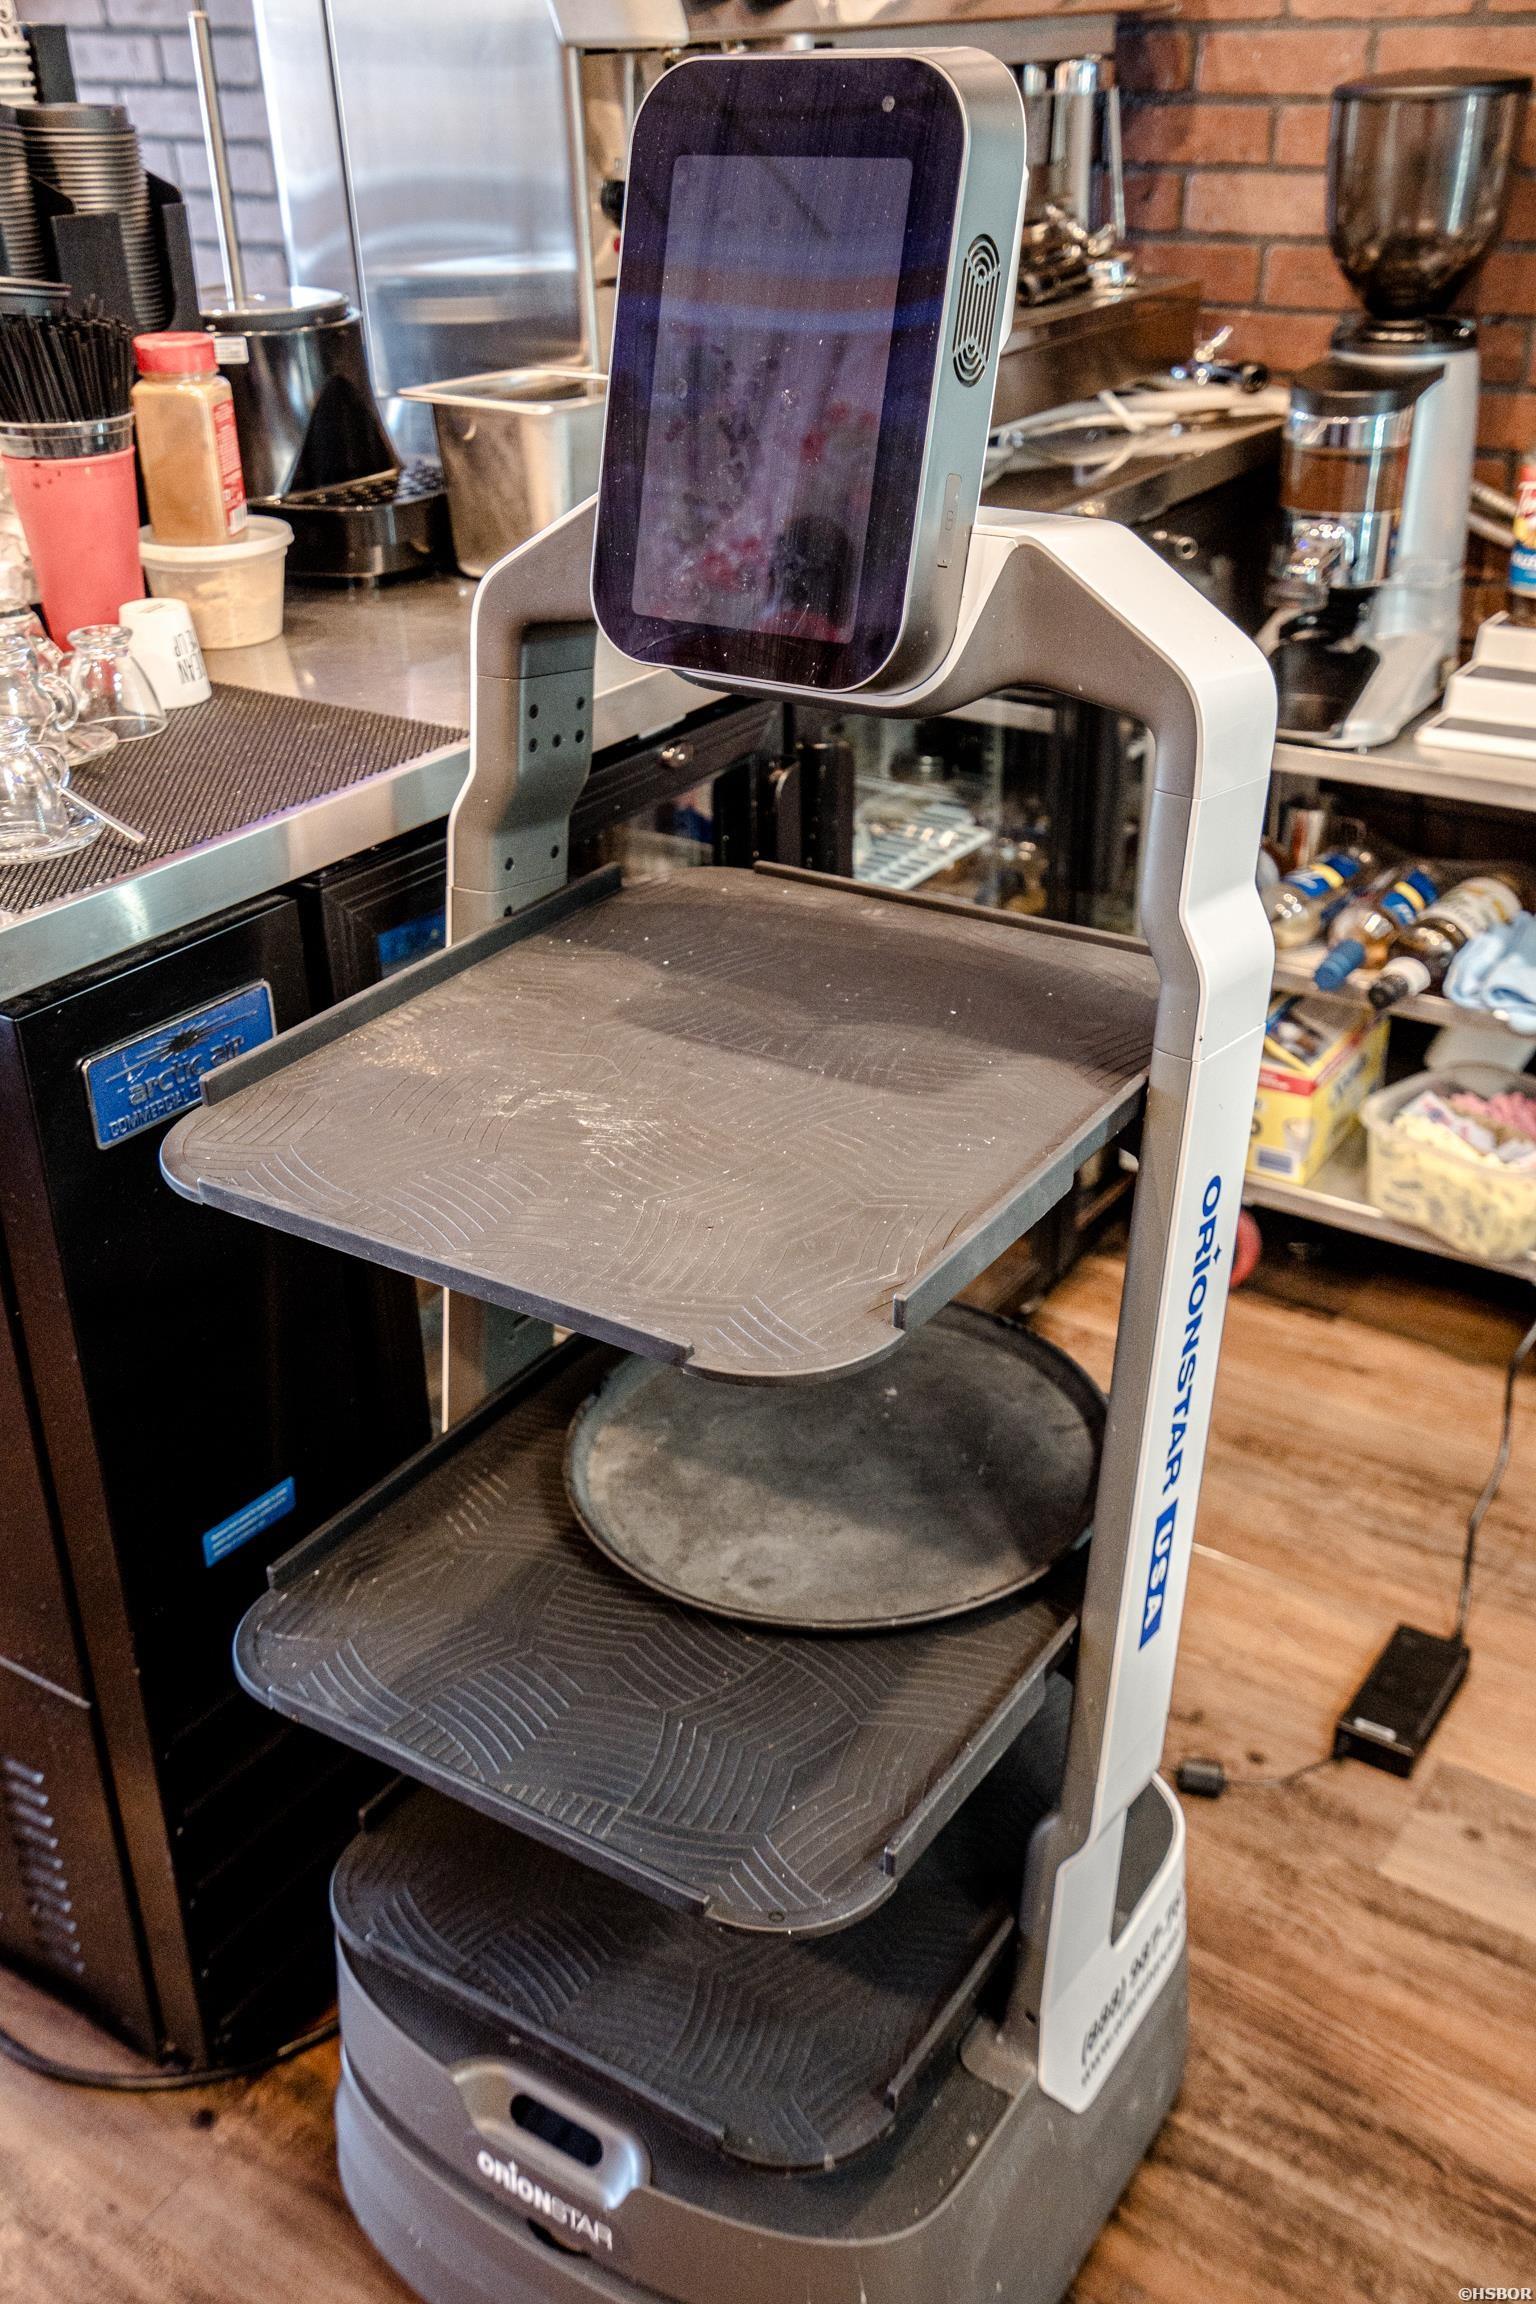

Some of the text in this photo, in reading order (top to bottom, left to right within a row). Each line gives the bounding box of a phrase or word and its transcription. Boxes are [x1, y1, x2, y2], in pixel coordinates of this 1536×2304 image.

[128, 1034, 245, 1105] arctic air
[1144, 1174, 1222, 1630] ORIONSTAR USA
